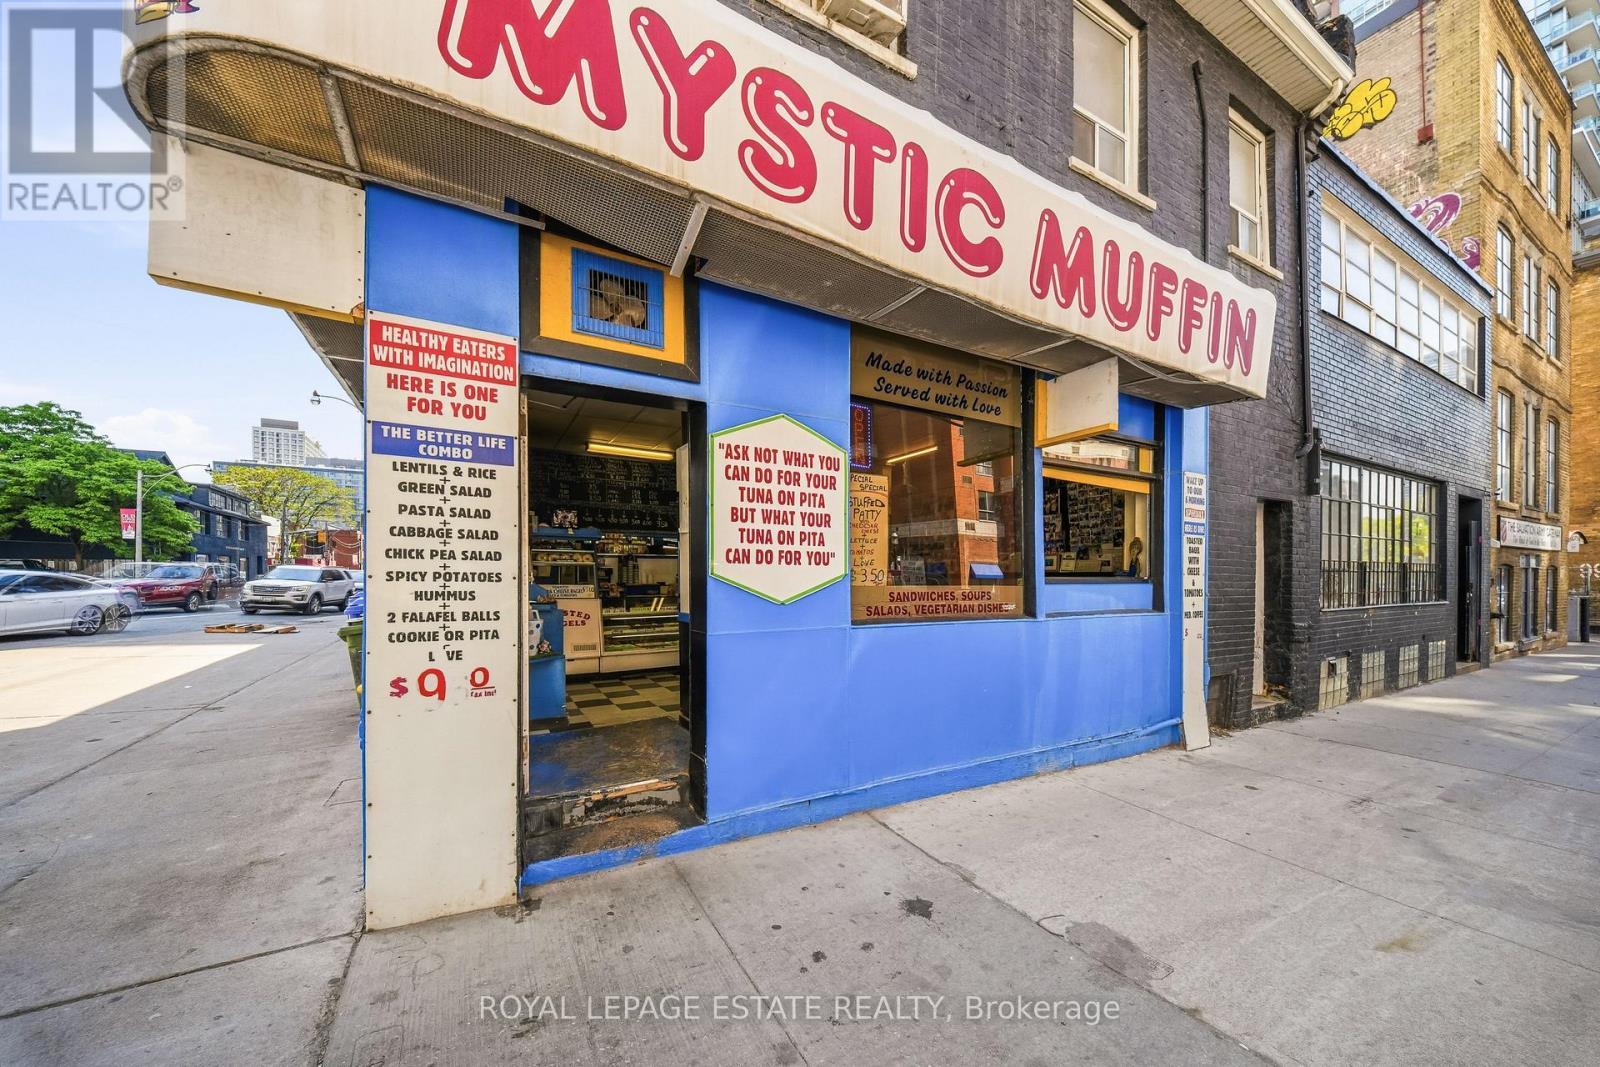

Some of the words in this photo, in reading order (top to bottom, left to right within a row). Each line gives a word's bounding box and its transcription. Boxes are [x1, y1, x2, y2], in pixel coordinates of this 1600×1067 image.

[437, 0, 1005, 278] MYSTIC
[1030, 208, 1256, 377] MUFFIN
[381, 325, 448, 352] HEALTHY
[453, 337, 505, 361] EATERS
[372, 344, 414, 366] WITH
[418, 352, 514, 382] IMAGINATION
[864, 351, 913, 377] Made
[916, 368, 953, 386] with
[956, 374, 1008, 399] Passion
[387, 373, 434, 394] HERE
[441, 380, 457, 397] IS
[464, 384, 498, 404] ONE
[873, 376, 931, 402] Served
[935, 393, 968, 410] with
[972, 397, 1002, 417] Love
[407, 397, 443, 416] FOR
[450, 402, 487, 421] YOU
[381, 425, 411, 440] THE
[416, 429, 473, 446] BETTER
[478, 436, 507, 449] LIFE
[418, 444, 473, 460] COMBO
[718, 442, 750, 462] "ASK
[754, 447, 779, 465] NOT
[783, 450, 815, 469] WHAT
[818, 455, 841, 472] YOU
[392, 461, 448, 476] LENTILS
[453, 466, 463, 477] &
[467, 467, 497, 480] RICE
[724, 464, 750, 482] CAN
[754, 467, 773, 484] DO
[777, 470, 801, 487] FOR
[805, 472, 837, 491] YOUR
[850, 473, 873, 483] PECIAL
[397, 481, 445, 495] GREEN
[450, 485, 492, 498] SALAD
[859, 484, 887, 492] SPECIAL
[738, 486, 774, 505] TUNA
[777, 489, 795, 507] ON
[799, 491, 826, 509] PITA
[398, 504, 445, 517] PASTA
[449, 507, 492, 520] SALAD
[730, 506, 756, 524] BUT
[761, 508, 796, 526] WHAT
[799, 511, 832, 528] YOUR
[853, 508, 882, 522] PATTY
[389, 526, 453, 539] CABBAGE
[457, 529, 499, 541] SALAD
[738, 527, 774, 545] TUNA
[777, 529, 795, 546] ON
[799, 530, 826, 547] PITA
[384, 548, 425, 560] CHICK
[429, 549, 457, 561] PEA
[461, 550, 503, 562] SALAD
[725, 547, 751, 565] CAN
[755, 549, 774, 565] DO
[778, 550, 802, 566] FOR
[806, 551, 836, 567] YOU"
[853, 559, 875, 567] LOVE
[385, 571, 428, 582] SPICY
[432, 571, 503, 583] POTATOES
[414, 590, 476, 602] HUMMUS
[961, 590, 992, 601] SOUPS
[387, 612, 396, 624] 2
[401, 611, 457, 623] FALAFEL
[461, 610, 501, 622] BALLS
[563, 610, 591, 620] STED
[865, 604, 911, 617] SALADS,
[914, 603, 975, 616] VEGETARIAN
[563, 619, 587, 627] GELS
[387, 631, 440, 643] COOKIE
[444, 630, 464, 641] OR
[469, 629, 500, 641] PITA
[428, 650, 463, 662] LVE
